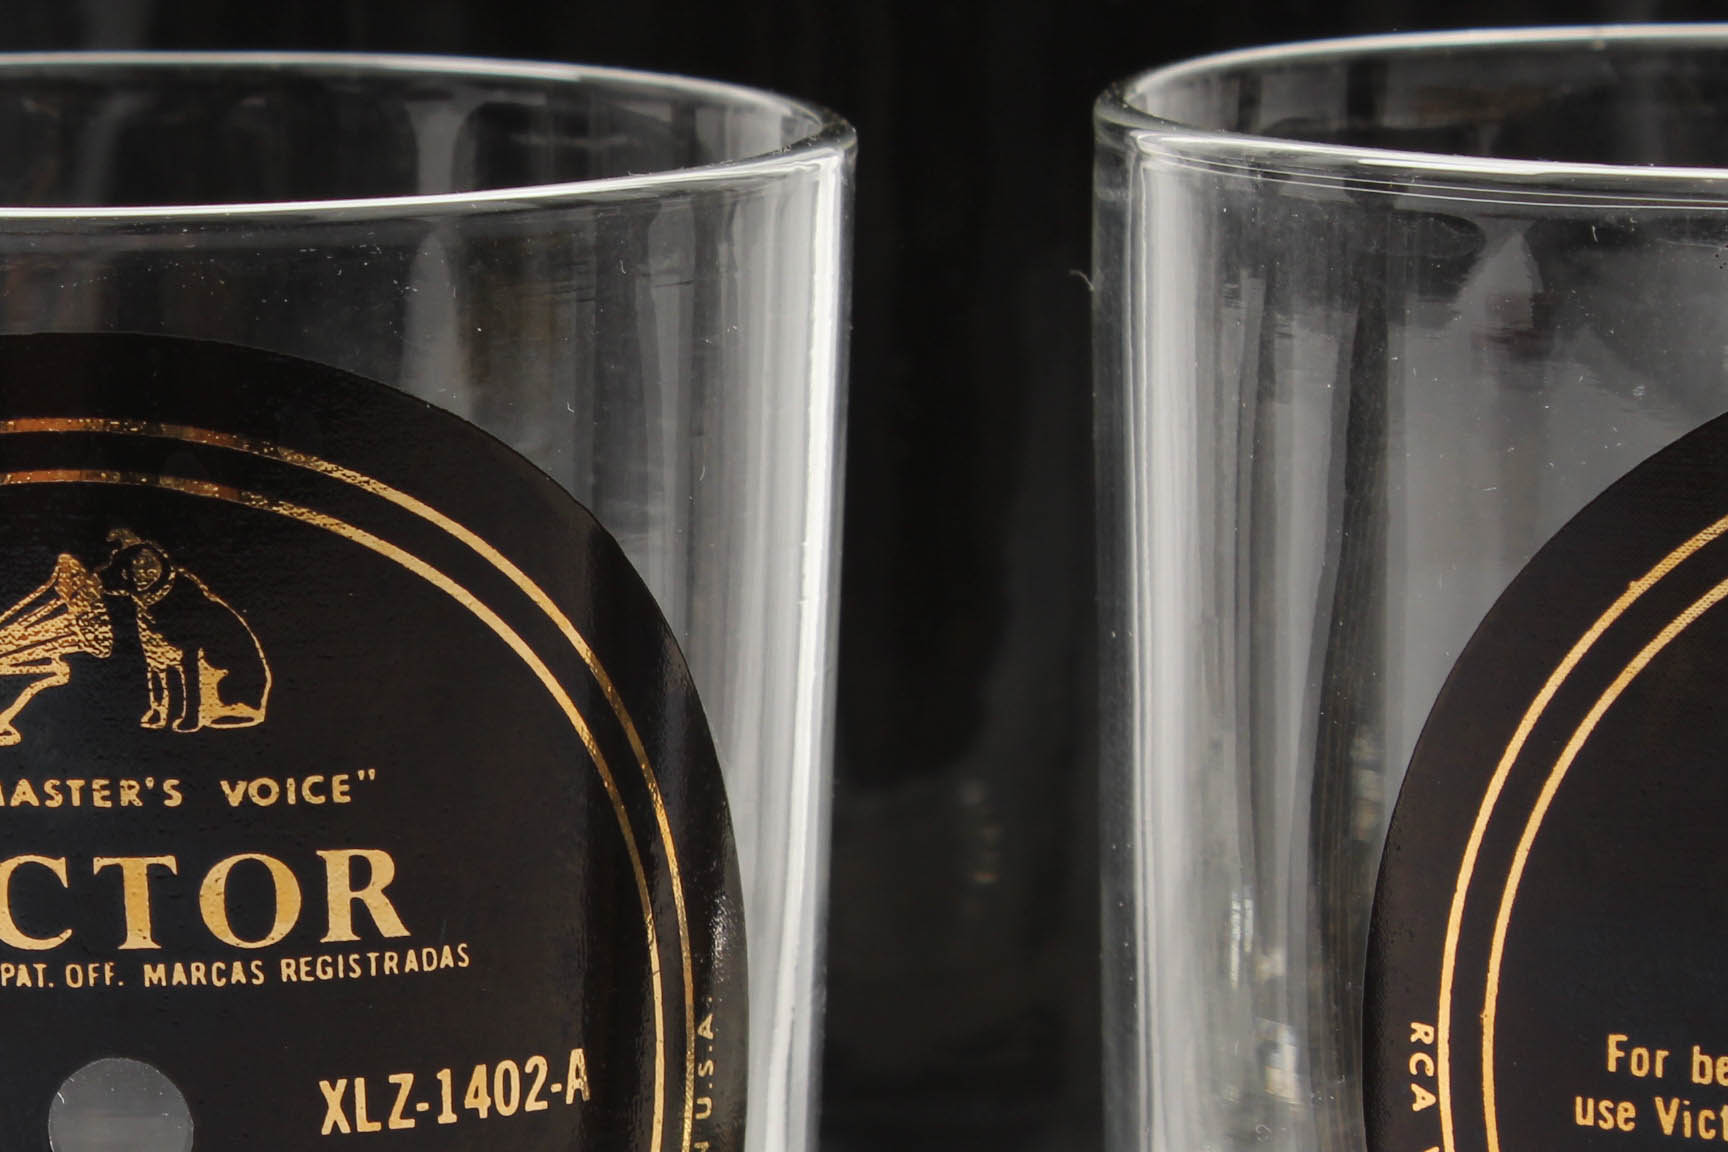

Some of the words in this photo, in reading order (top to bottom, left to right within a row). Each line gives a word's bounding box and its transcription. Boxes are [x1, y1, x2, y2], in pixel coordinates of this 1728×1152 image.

[219, 768, 377, 807] VOICE"
[0, 962, 55, 988] PAT.
[65, 962, 124, 988] OFF.
[142, 959, 266, 988] MARCAS
[279, 943, 471, 983] REGISTRADAS
[1409, 1021, 1437, 1113] RCA
[1607, 1033, 1671, 1079] For
[318, 1047, 591, 1136] XLZ-1402-A
[1574, 1096, 1637, 1132] use
